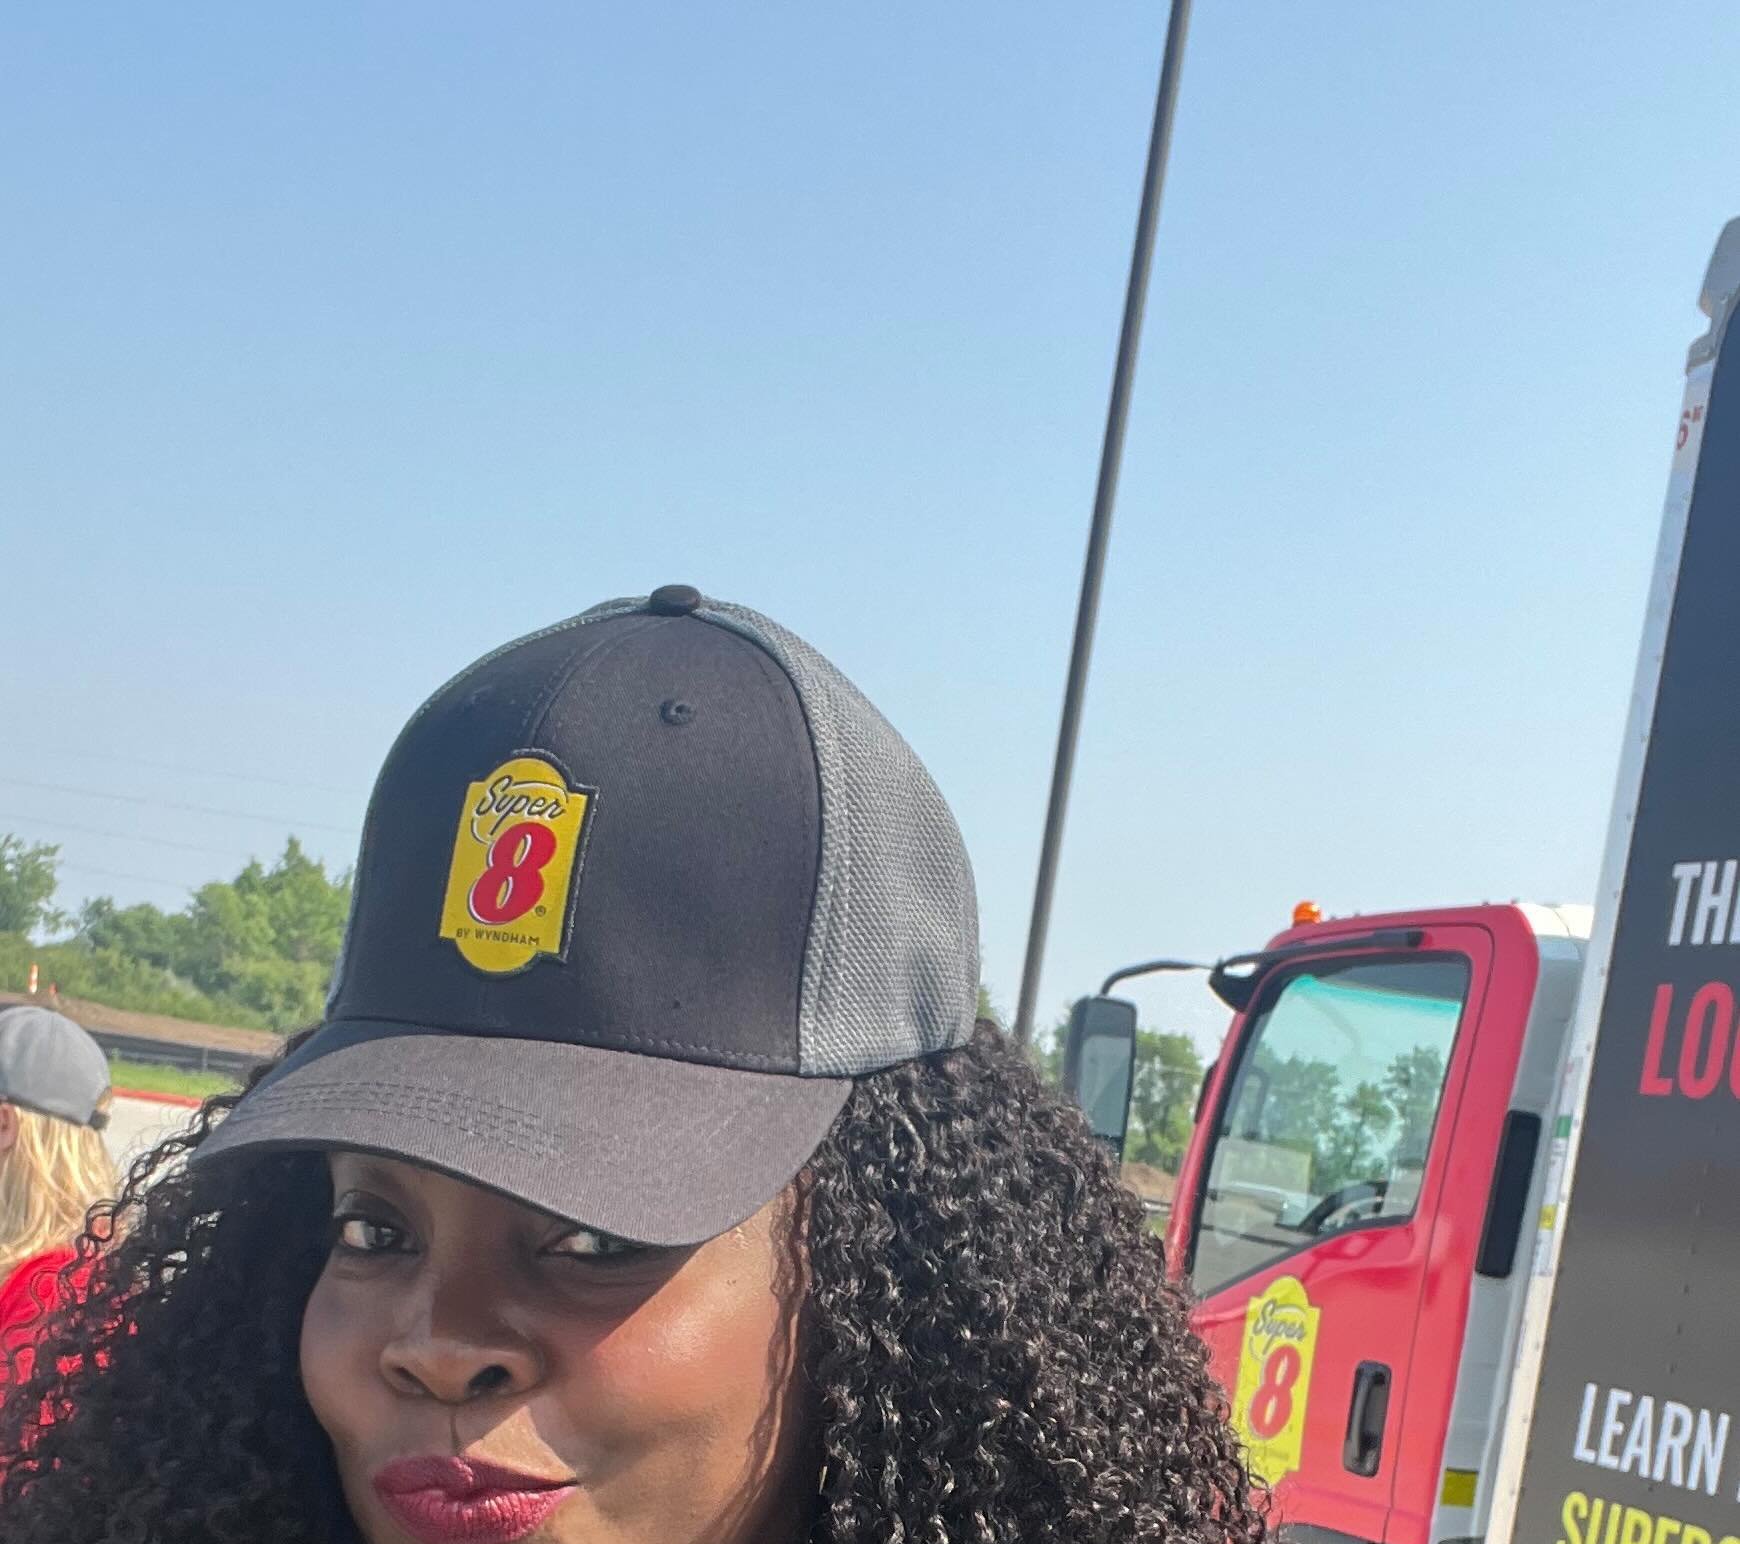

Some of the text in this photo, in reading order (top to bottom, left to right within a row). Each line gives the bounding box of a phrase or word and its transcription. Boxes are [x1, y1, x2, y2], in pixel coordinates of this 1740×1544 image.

[473, 775, 568, 836] Super
[468, 822, 557, 925] 8
[456, 927, 540, 946] BY WYNDHAM
[1251, 1298, 1308, 1356] Super
[1248, 1344, 1302, 1440] 8
[1573, 1382, 1731, 1497] LEARN
